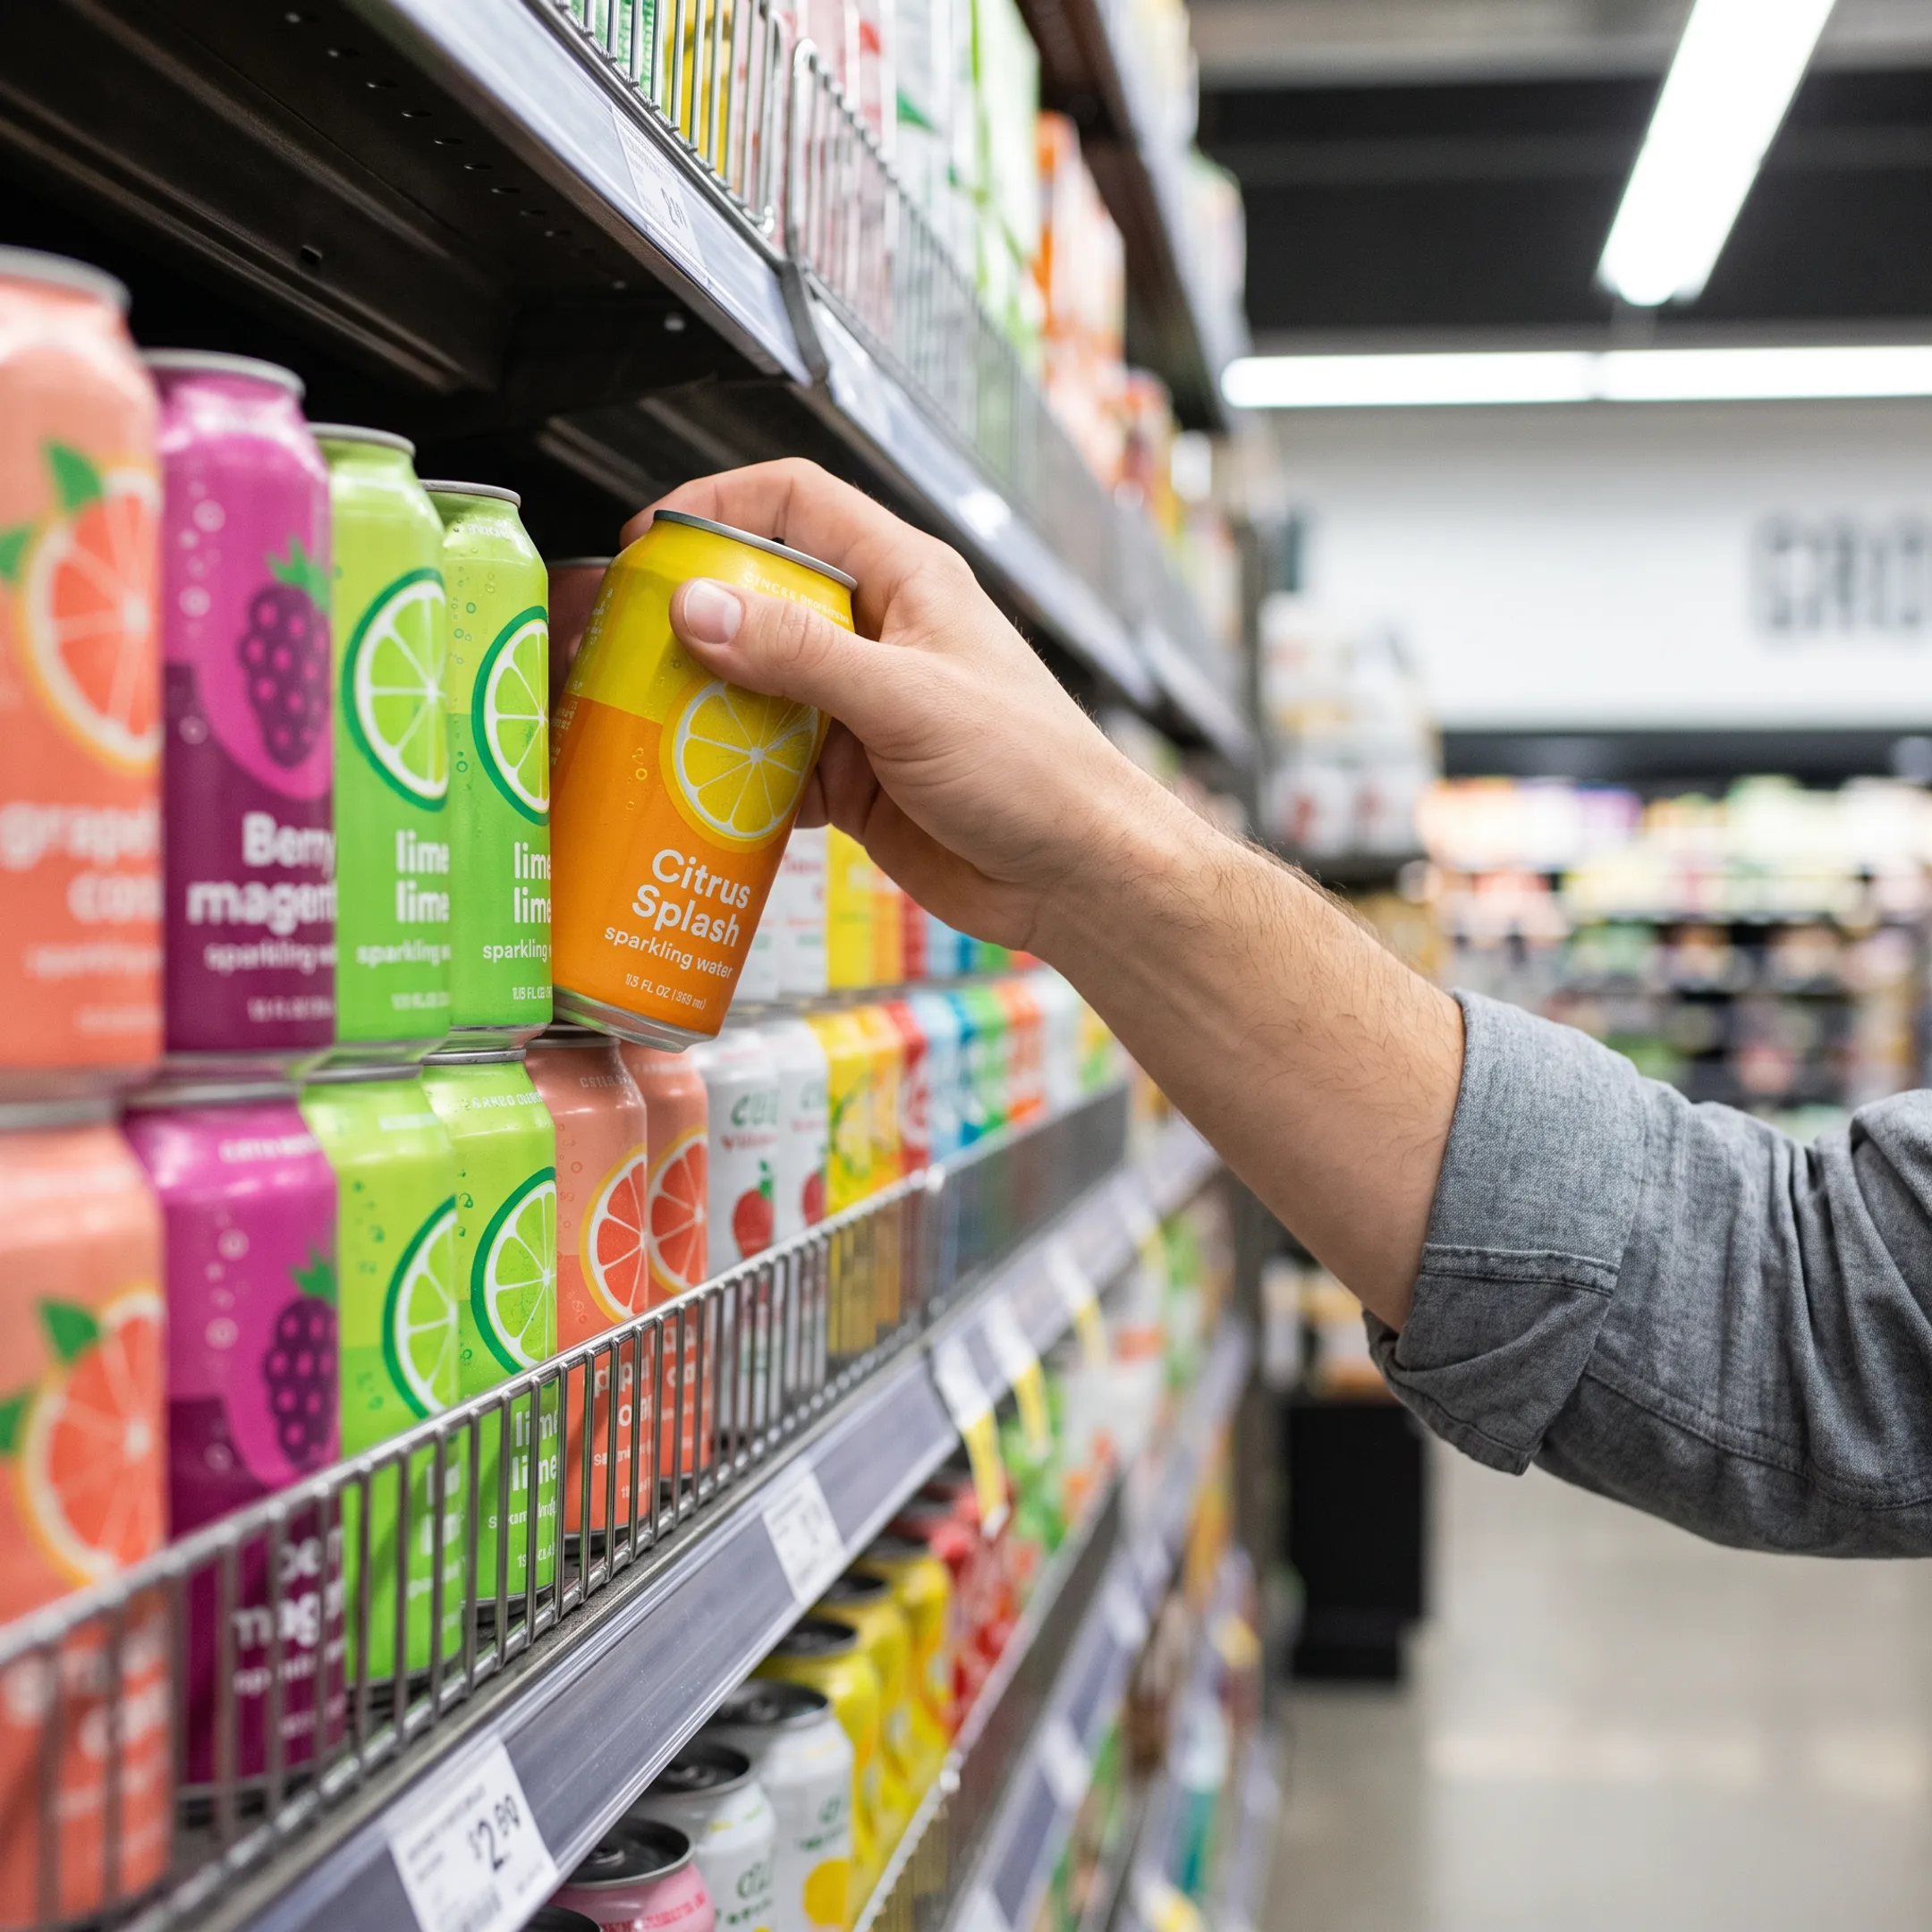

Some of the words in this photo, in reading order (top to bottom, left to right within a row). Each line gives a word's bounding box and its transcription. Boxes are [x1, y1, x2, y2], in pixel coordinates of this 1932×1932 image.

[513, 842, 551, 880] lime
[651, 849, 750, 909] Citrus
[513, 886, 551, 924] lime
[631, 884, 740, 948] Splash
[356, 938, 441, 968] sparkling
[482, 938, 547, 963] sparkling
[604, 927, 693, 970] sparkling
[696, 956, 733, 979] water
[640, 979, 654, 994] FL
[656, 984, 671, 999] OZ
